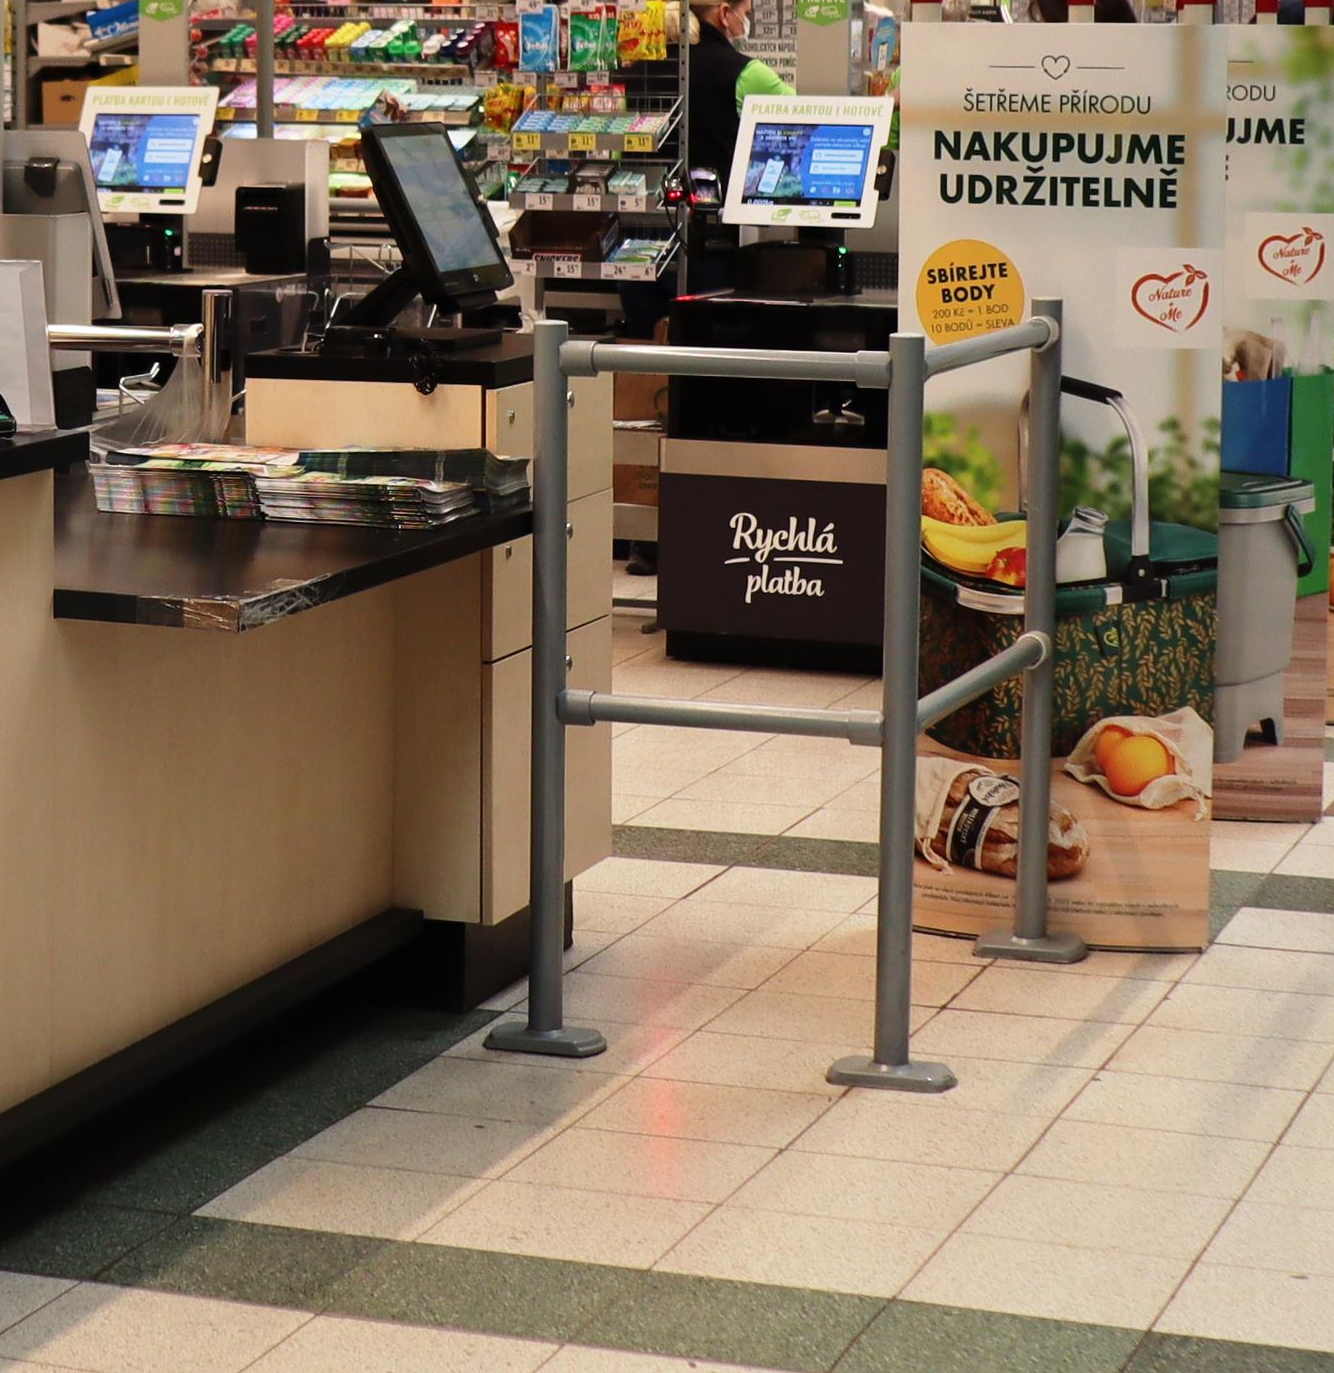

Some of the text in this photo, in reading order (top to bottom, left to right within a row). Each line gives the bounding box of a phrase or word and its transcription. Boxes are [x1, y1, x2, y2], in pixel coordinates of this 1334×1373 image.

[751, 103, 789, 115] PLATBA
[792, 104, 833, 116] KARTOU
[843, 104, 884, 117] HOTOVĚ
[963, 87, 1151, 115] ŠETŘEME PŘÍRODU
[934, 130, 1185, 165] NAKUPUJME
[940, 165, 1177, 208] UDRŽITELNĚ
[1273, 245, 1310, 259] Nature
[927, 261, 1009, 285] SBÍREJTE
[1282, 264, 1303, 277] Me
[941, 283, 995, 303] BODY
[1148, 285, 1192, 302] Nature
[933, 309, 951, 319] 200
[953, 307, 965, 317] Kč
[986, 304, 1009, 314] BOD
[1159, 308, 1183, 322] Me
[931, 323, 943, 333] 10
[944, 319, 974, 332] BODŮ
[985, 318, 1016, 329] SLEVA
[728, 512, 838, 564] Rychlá
[745, 564, 825, 604] platba
